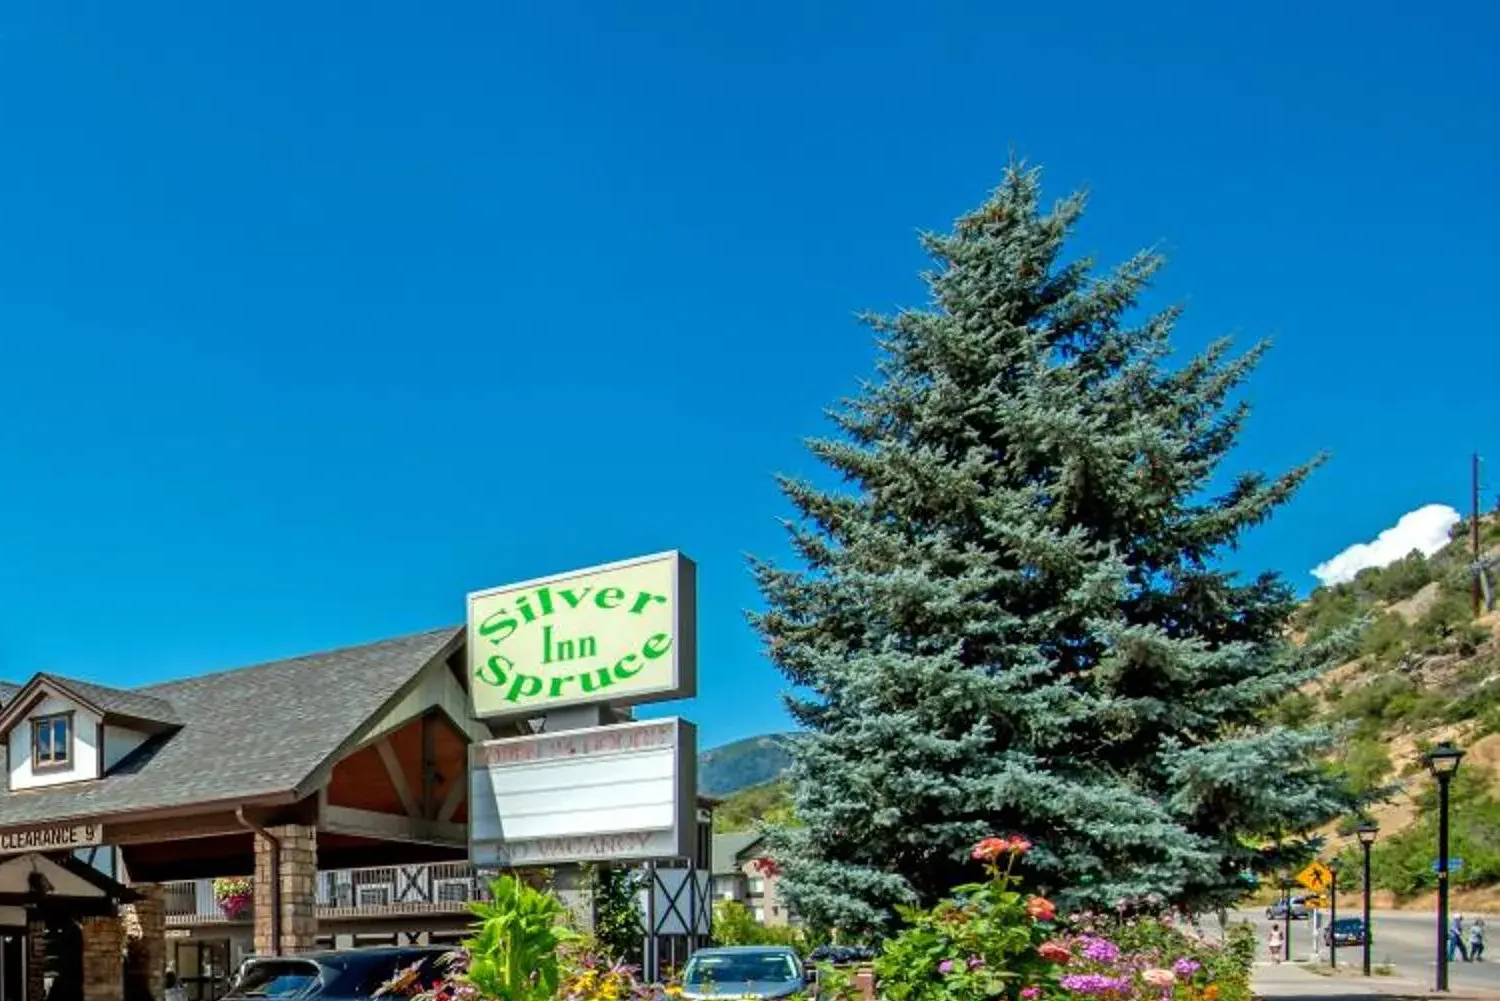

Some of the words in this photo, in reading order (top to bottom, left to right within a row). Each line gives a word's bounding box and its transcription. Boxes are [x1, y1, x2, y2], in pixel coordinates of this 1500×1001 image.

[478, 587, 668, 645] Silver
[475, 633, 674, 703] Spruce
[541, 624, 597, 664] Inn
[1, 825, 77, 849] CLEARANCE
